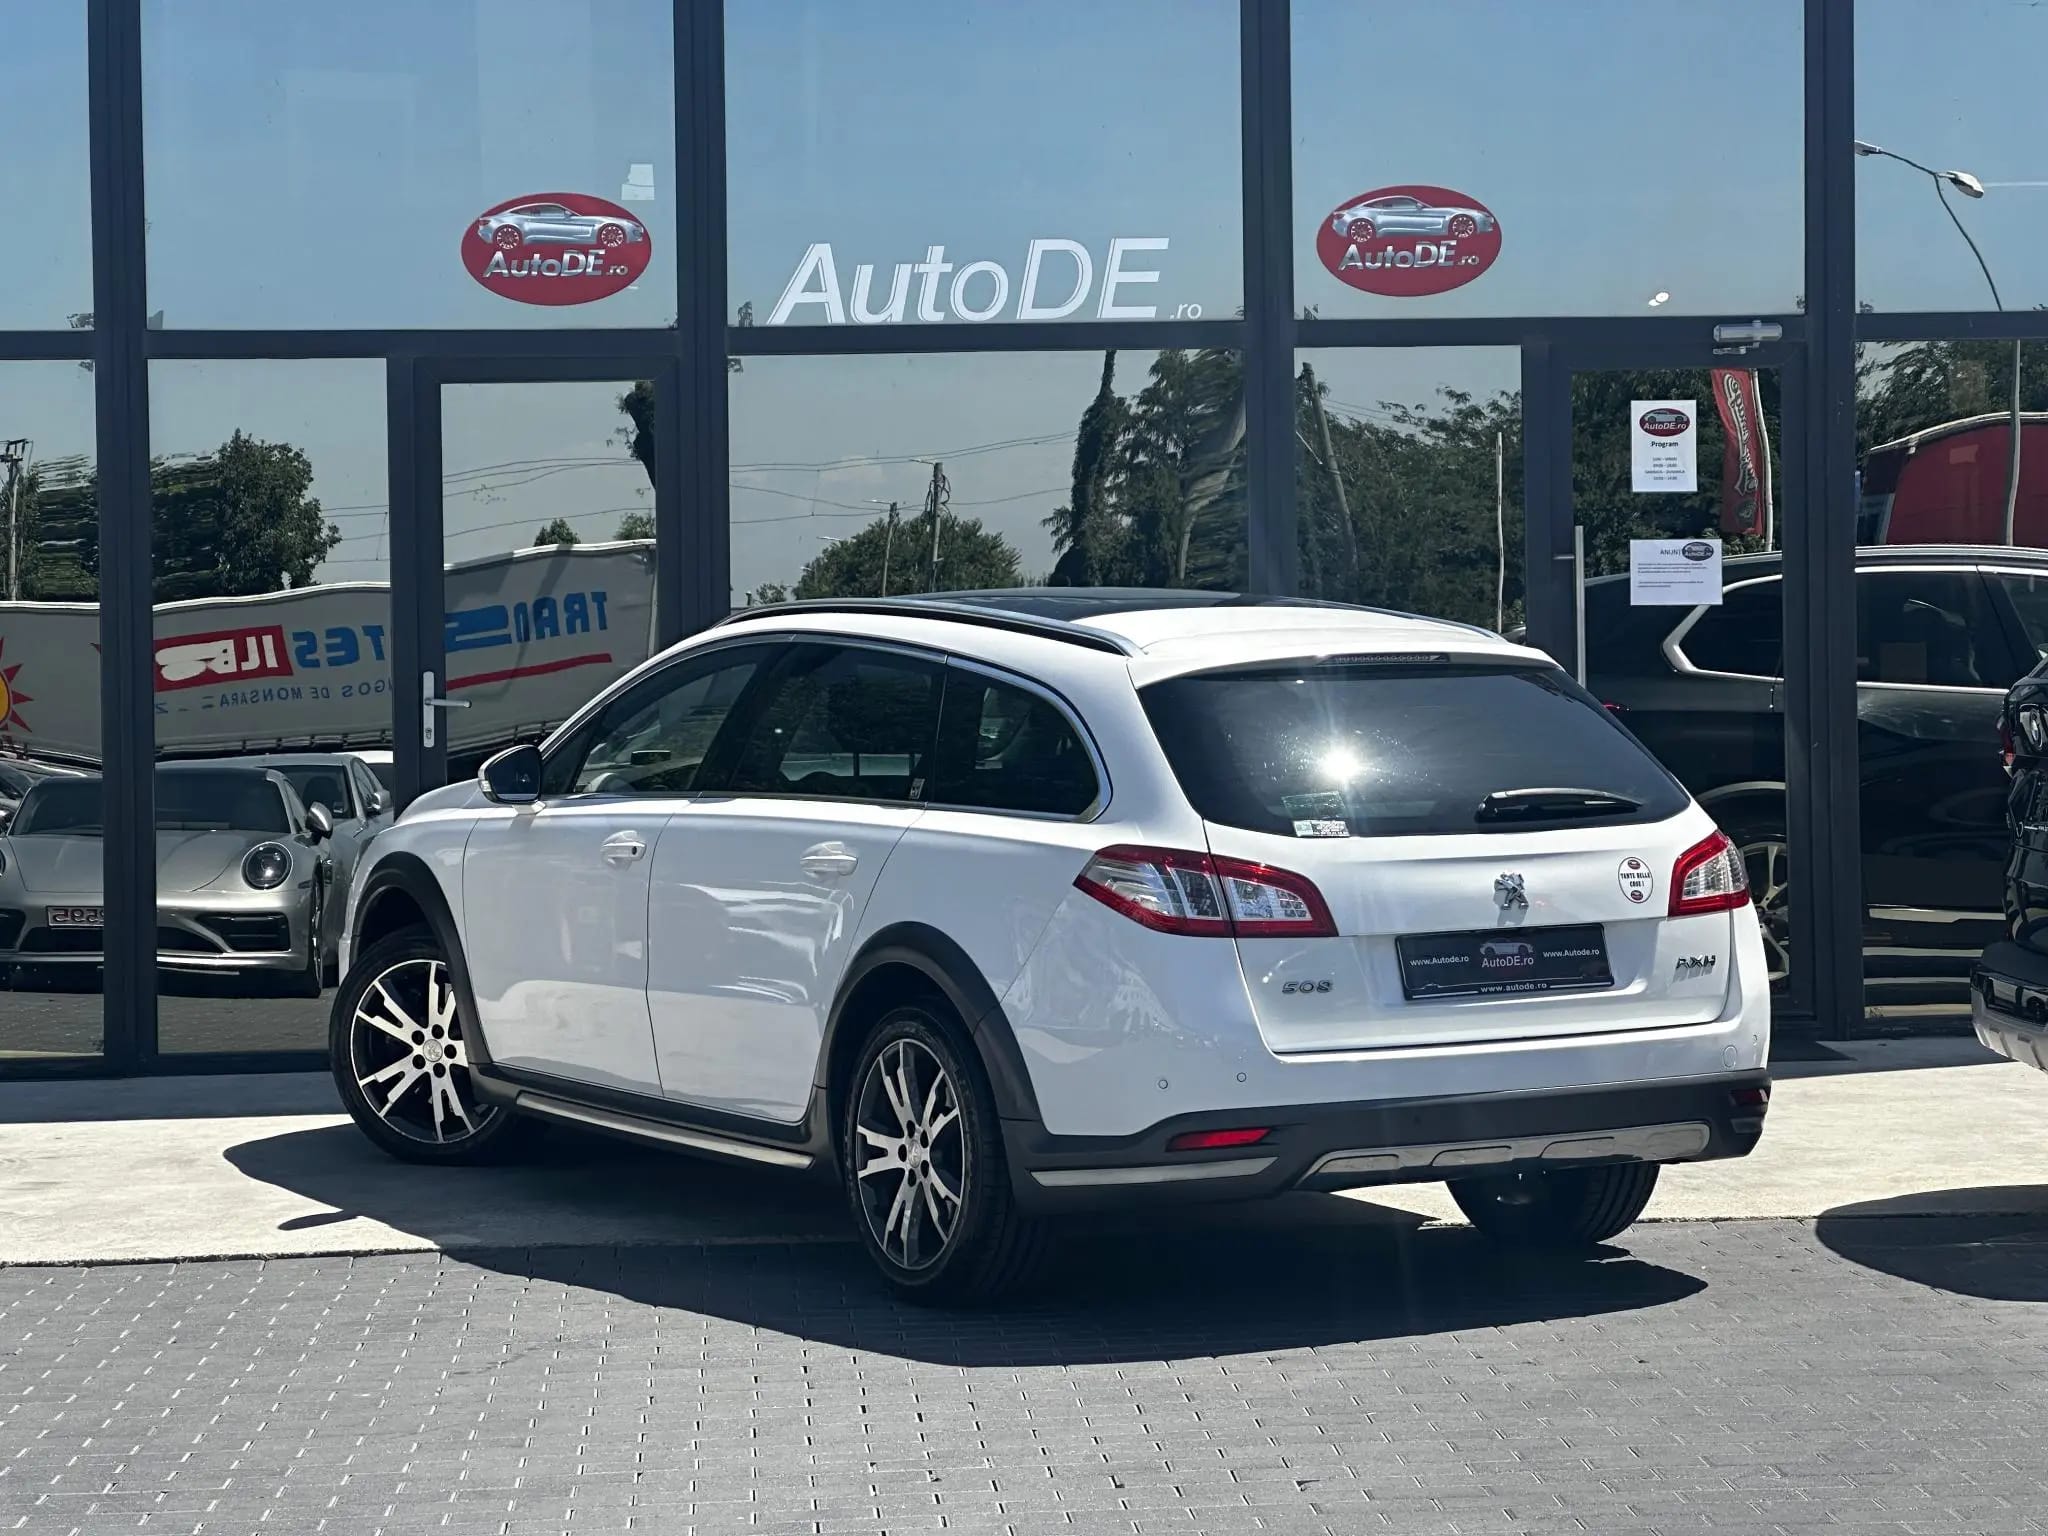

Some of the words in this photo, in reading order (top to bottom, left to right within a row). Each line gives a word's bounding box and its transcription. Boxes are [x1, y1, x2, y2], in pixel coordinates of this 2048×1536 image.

[1409, 955, 1470, 967] www.Autode.ro
[1481, 955, 1535, 968] AutoDE.ro
[1543, 948, 1600, 958] www.Autode.ro
[1282, 980, 1333, 994] 508
[1480, 982, 1547, 993] www.autode.ro
